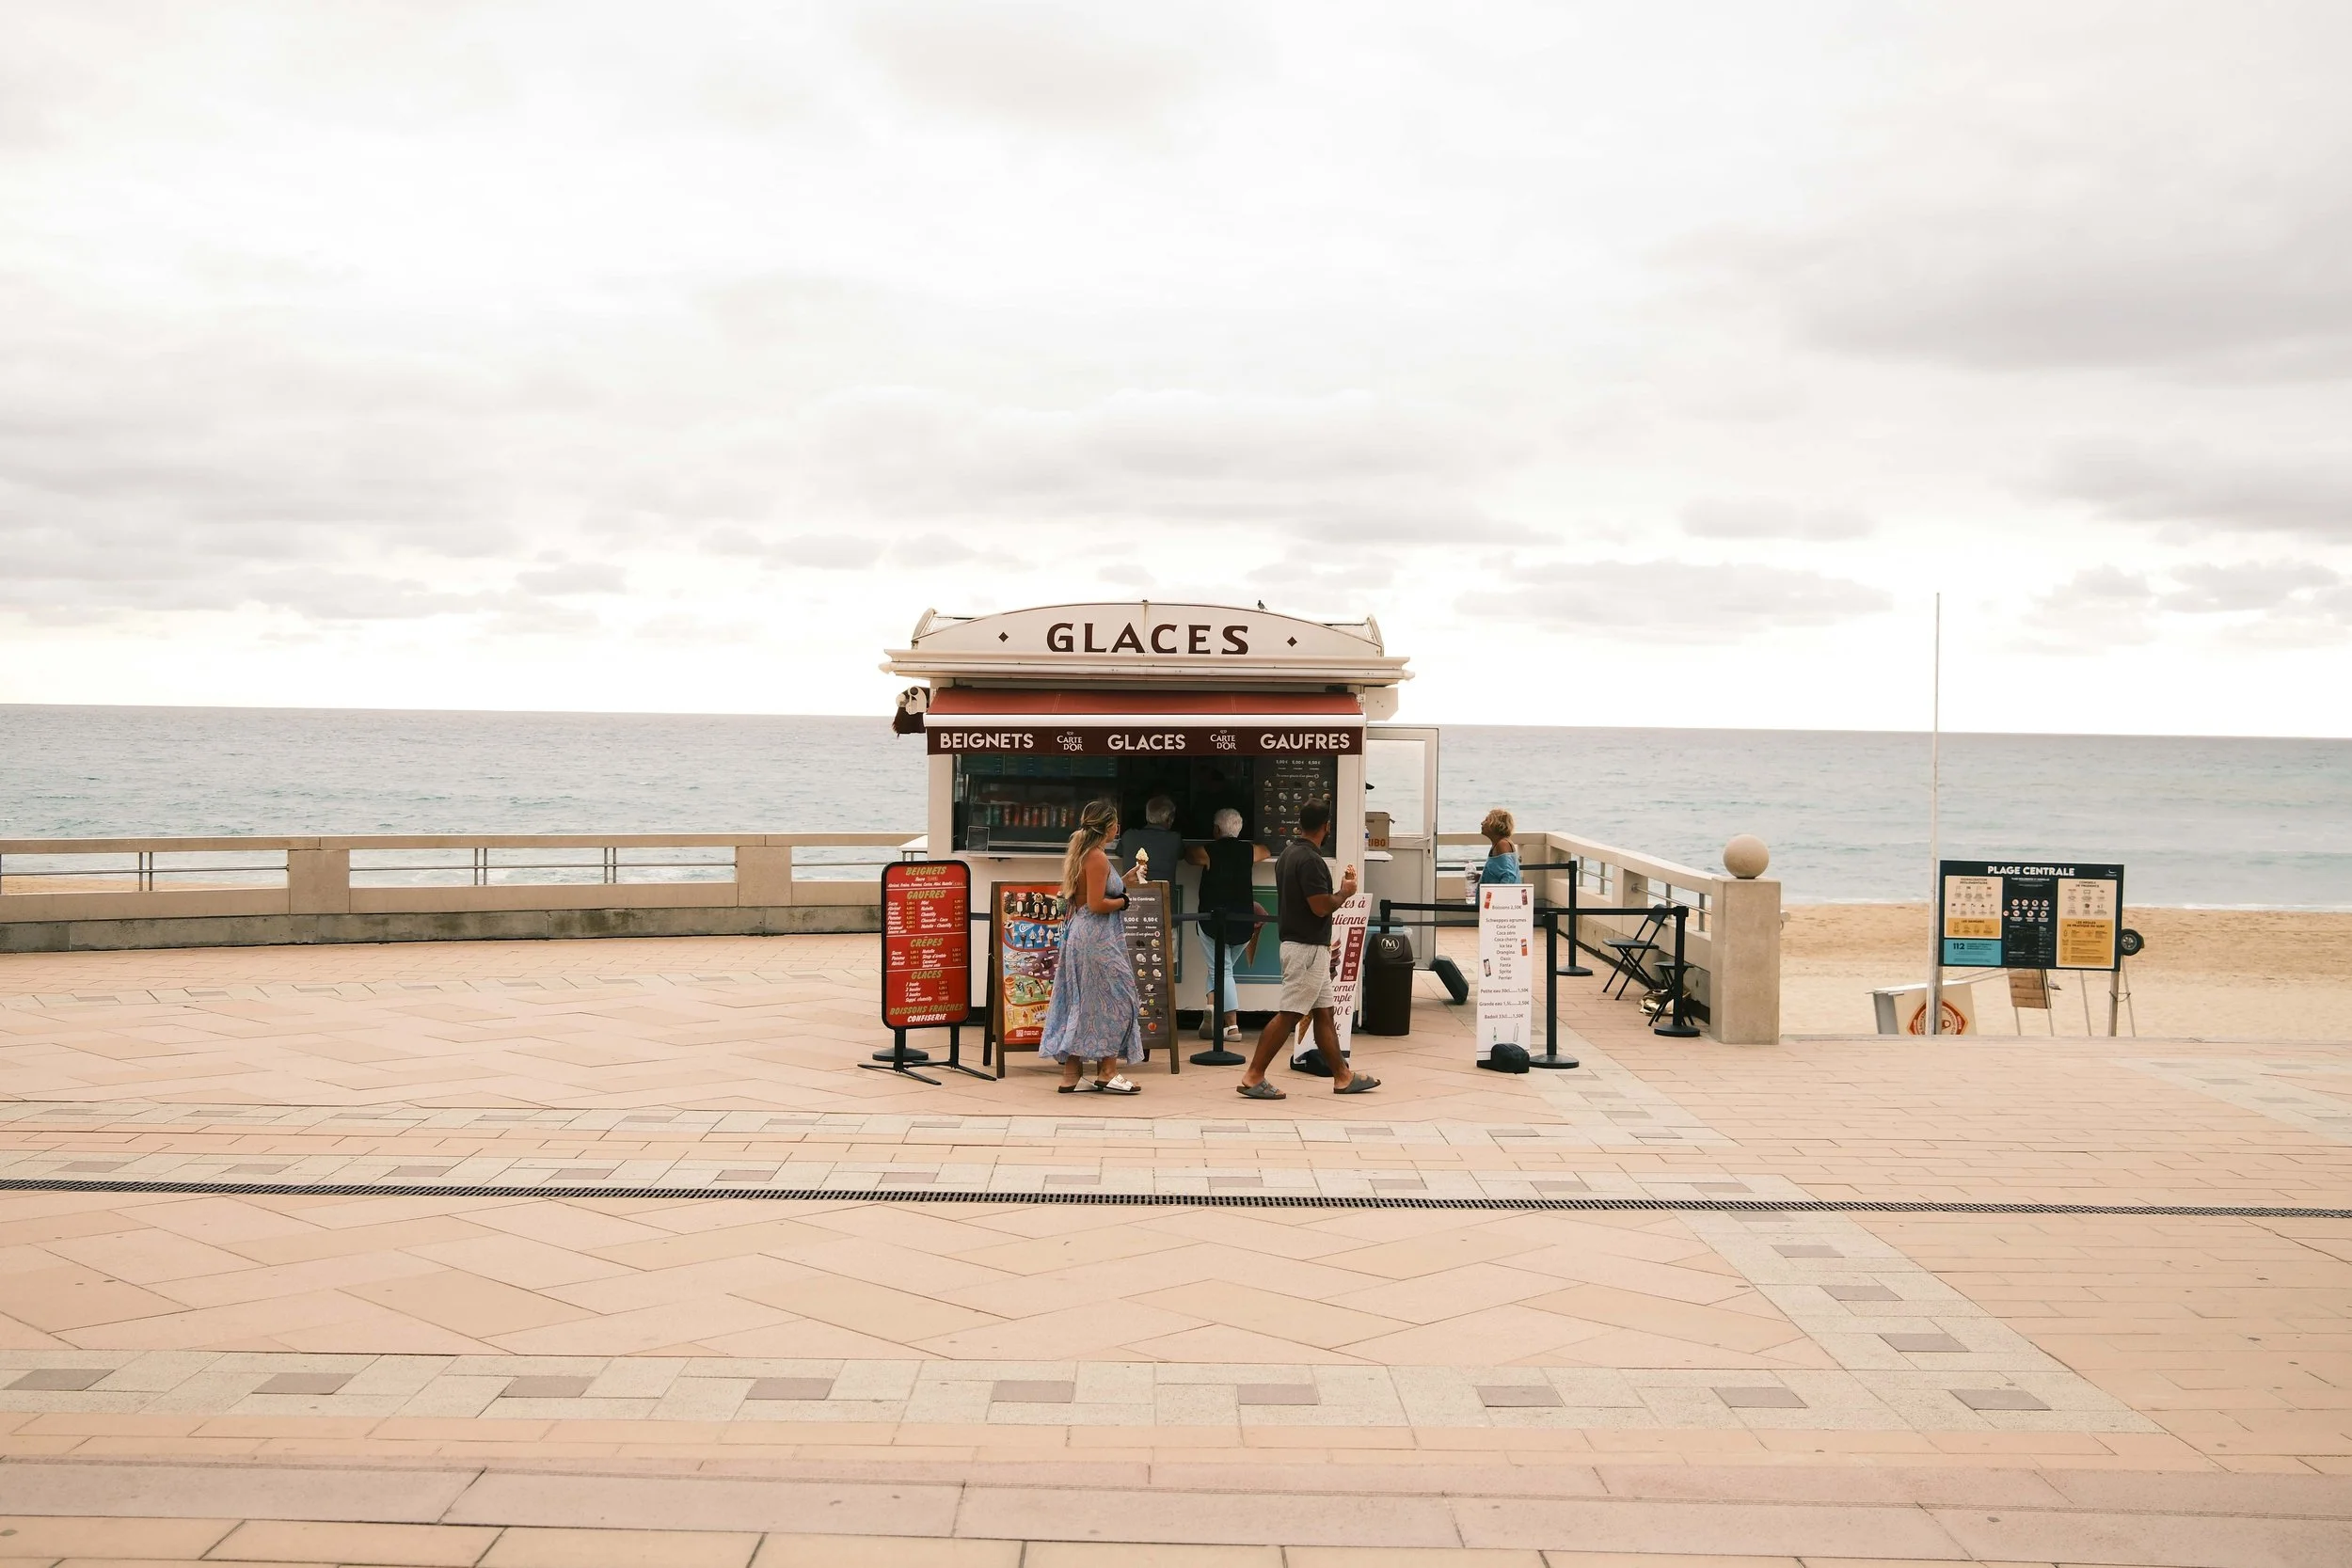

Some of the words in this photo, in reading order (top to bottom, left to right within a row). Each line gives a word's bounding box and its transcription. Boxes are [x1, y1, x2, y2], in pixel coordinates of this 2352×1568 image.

[1046, 622, 1249, 655] GLACES
[940, 733, 1033, 749] BEIGNETS
[1057, 735, 1082, 744] CARTE
[1107, 734, 1186, 750] GLACES
[1210, 734, 1236, 743] CARTE
[1260, 733, 1350, 749] GAUFRES
[1063, 742, 1083, 752] D'OR
[1216, 741, 1237, 750] D'OR
[906, 866, 947, 876] BEIGNETS
[1987, 866, 2020, 875] PLAGE
[2022, 867, 2075, 876] CENTRALE
[906, 890, 946, 900] GAUFRES
[911, 970, 942, 979] GLACES
[1332, 983, 1355, 992] ornet
[890, 1006, 928, 1016] BOISSONS
[1345, 1006, 1351, 1015] €
[907, 1014, 947, 1022] CONFISERIE
